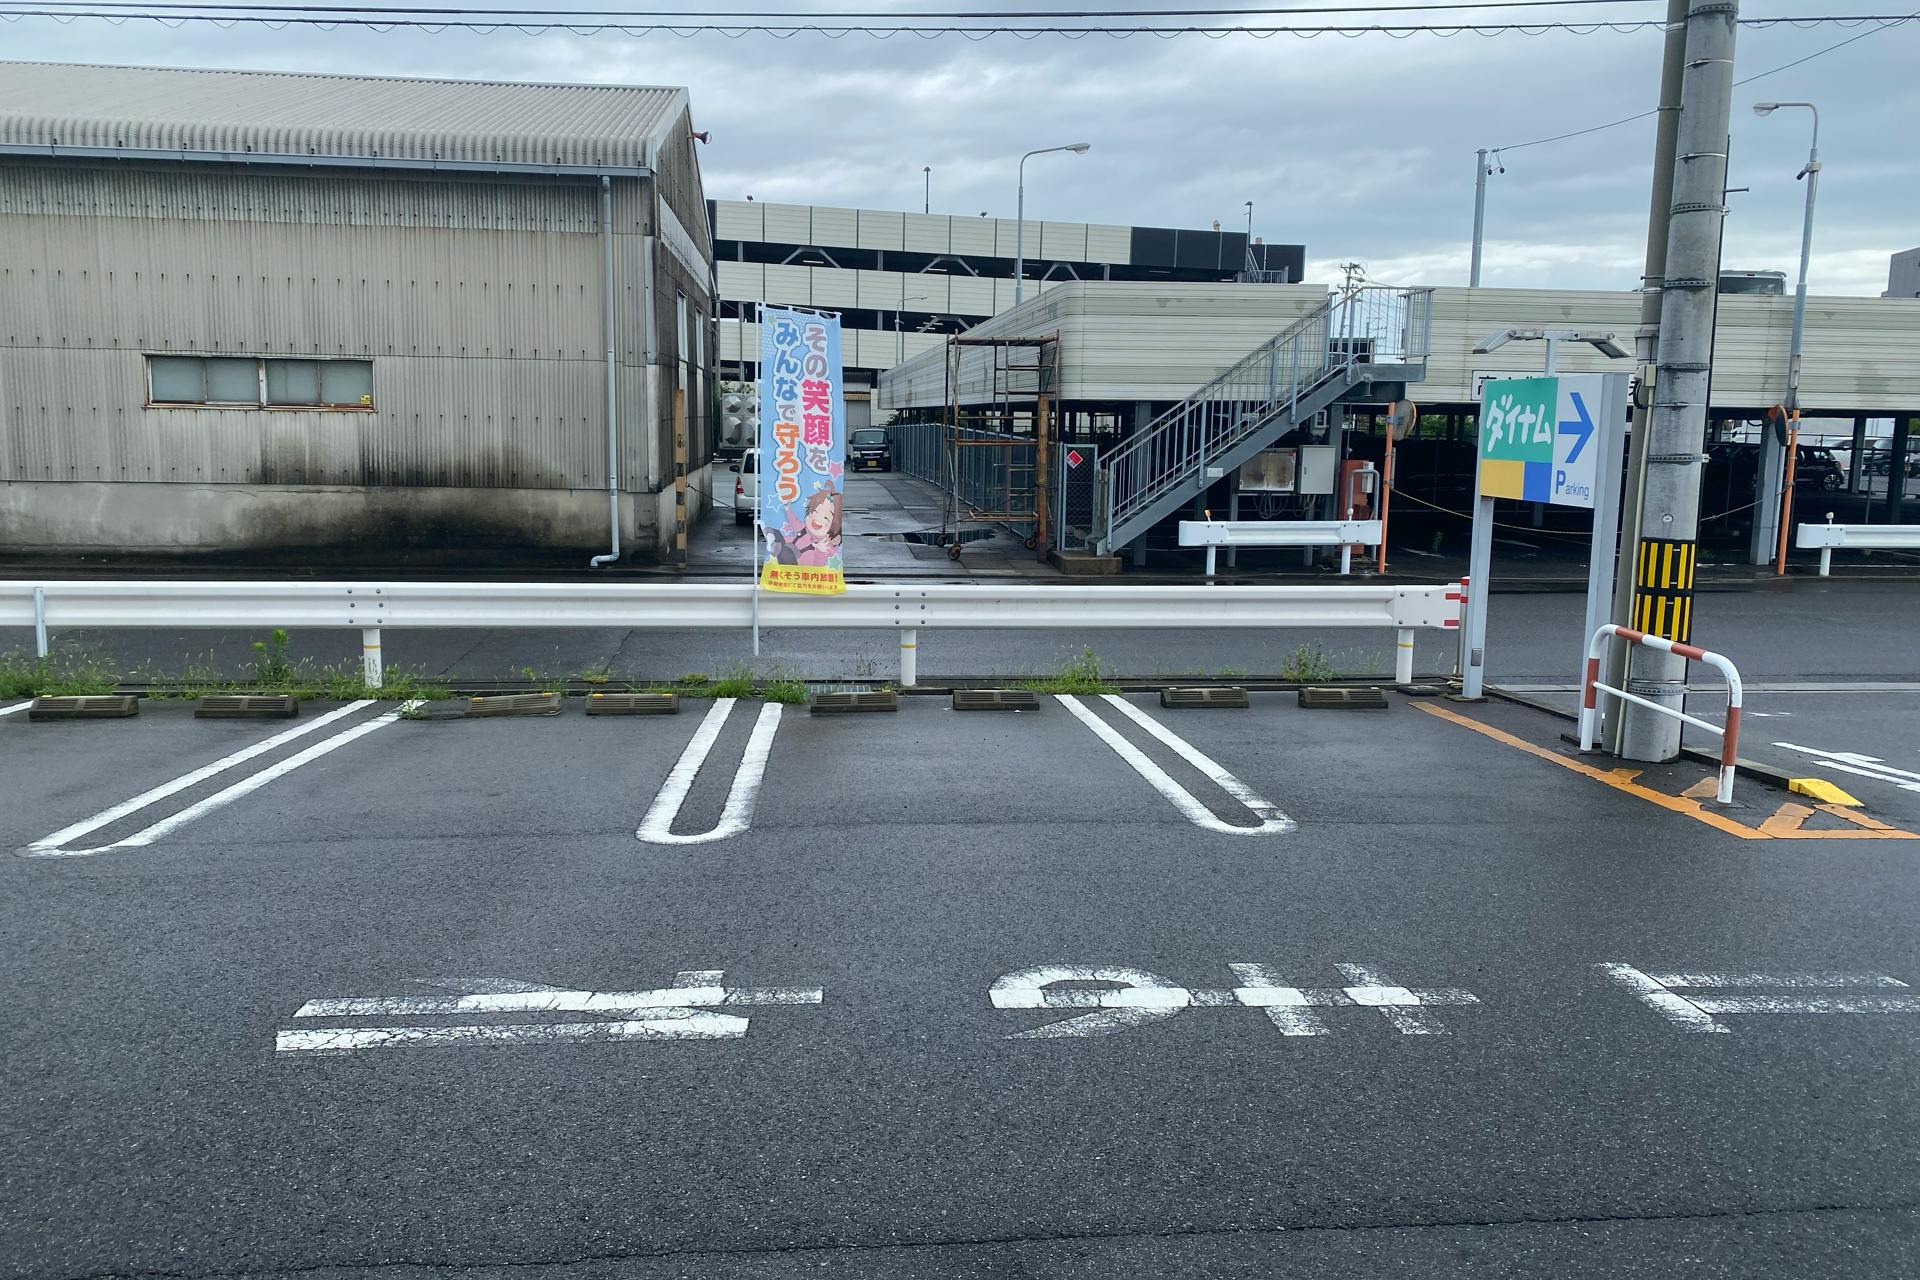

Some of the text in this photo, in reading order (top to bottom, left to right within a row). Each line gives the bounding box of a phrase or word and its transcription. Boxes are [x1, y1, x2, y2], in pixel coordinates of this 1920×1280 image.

[775, 322, 800, 501] みんなで守ろう
[802, 326, 831, 472] その笑顔を
[1486, 393, 1552, 453] ダイナム
[1555, 469, 1590, 500] Parking
